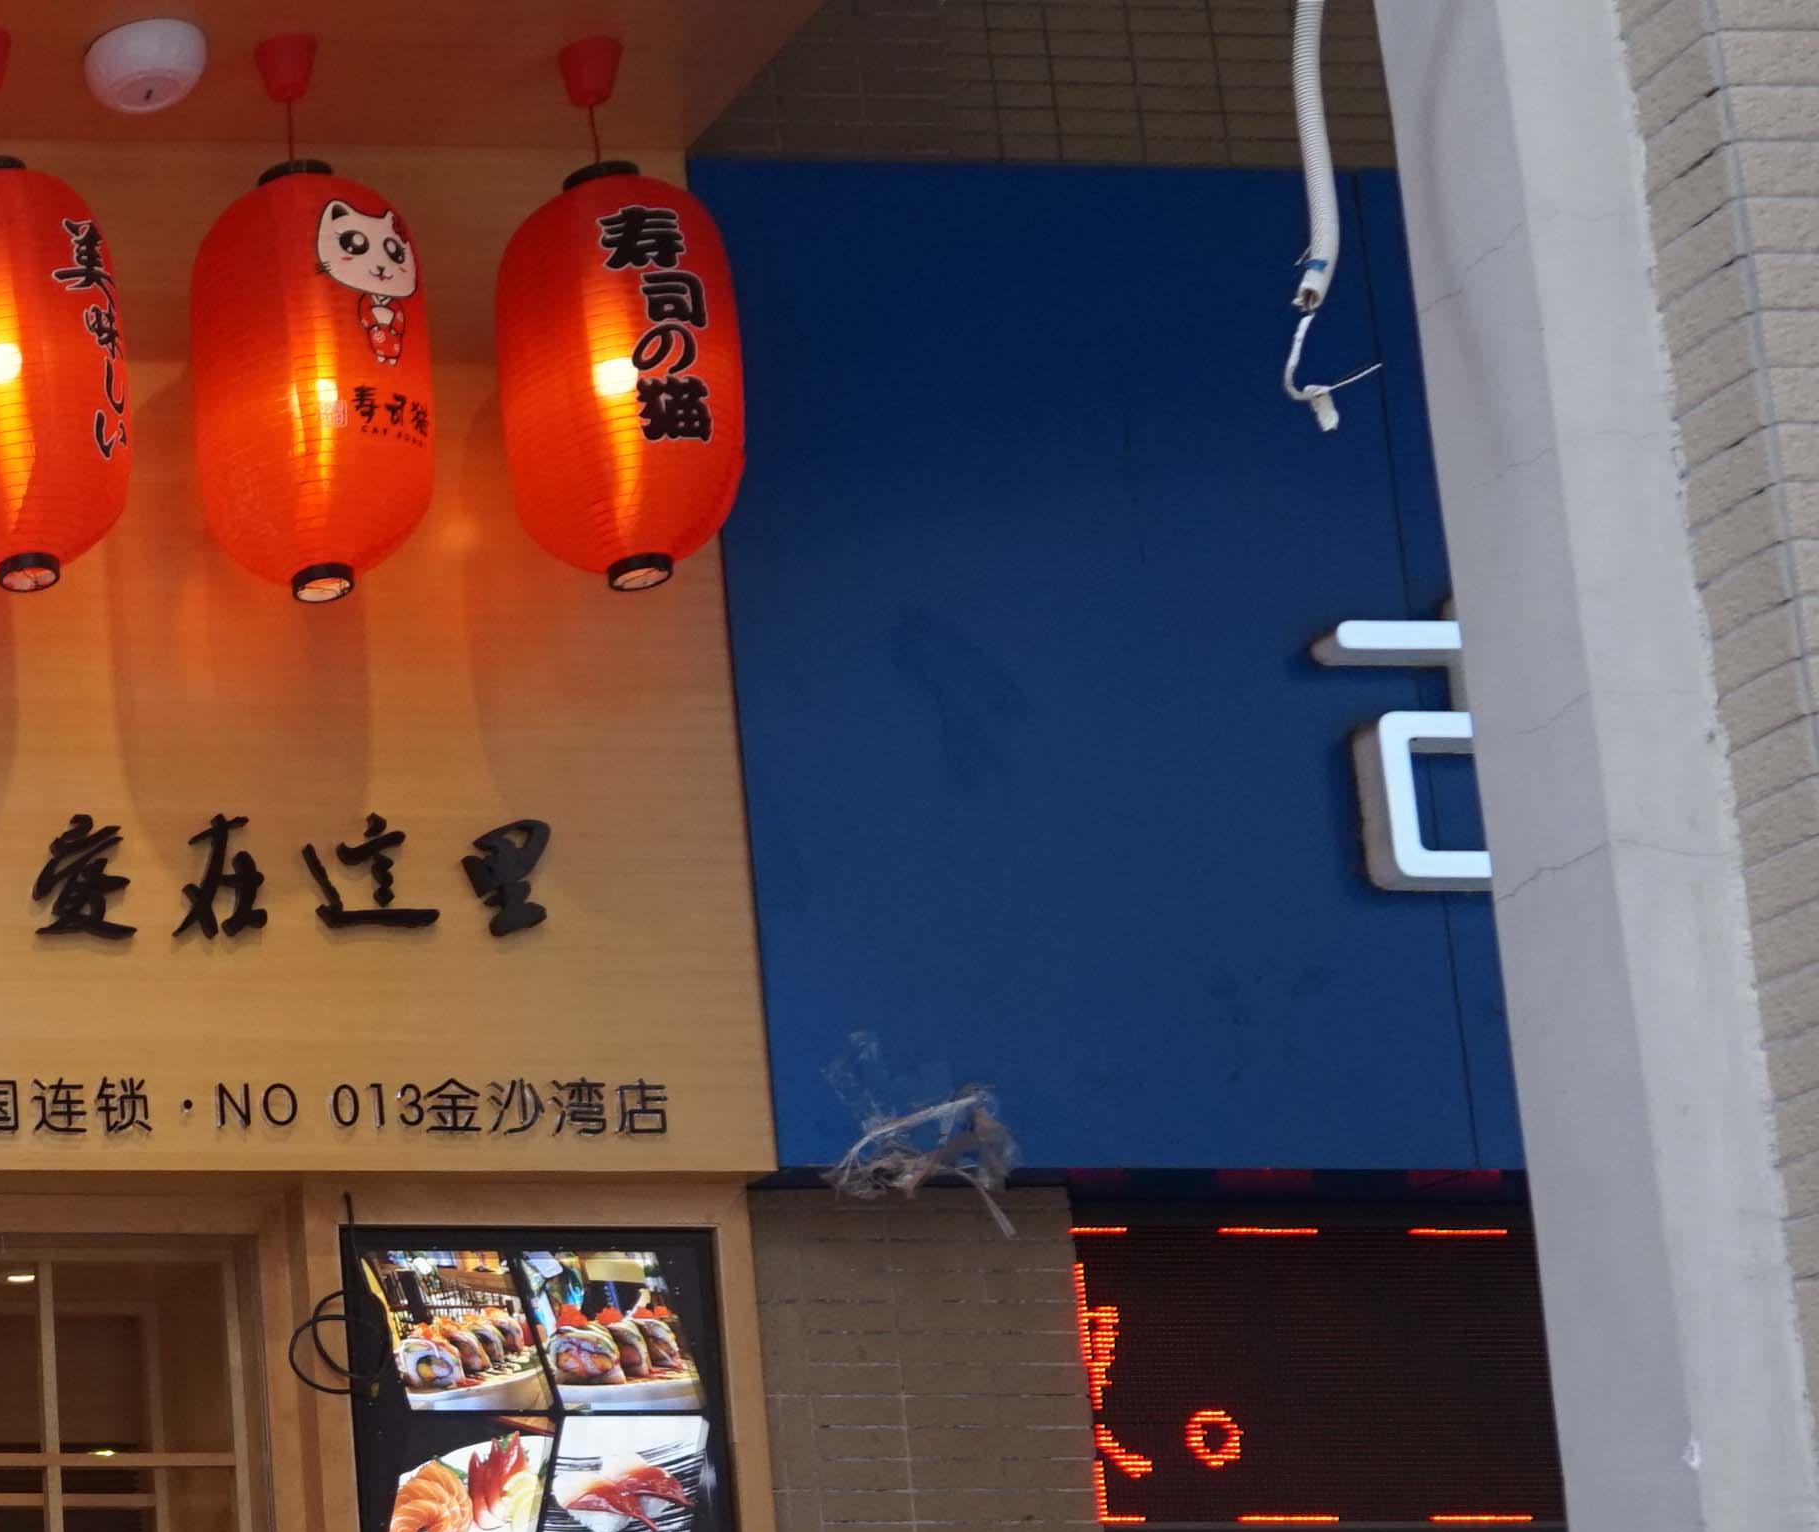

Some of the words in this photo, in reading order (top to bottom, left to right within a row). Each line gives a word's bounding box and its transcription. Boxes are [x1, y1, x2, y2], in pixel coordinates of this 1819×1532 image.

[52, 218, 128, 460] 美味しい
[351, 385, 428, 438] 寿司猫
[597, 204, 713, 445] 寿司の猫
